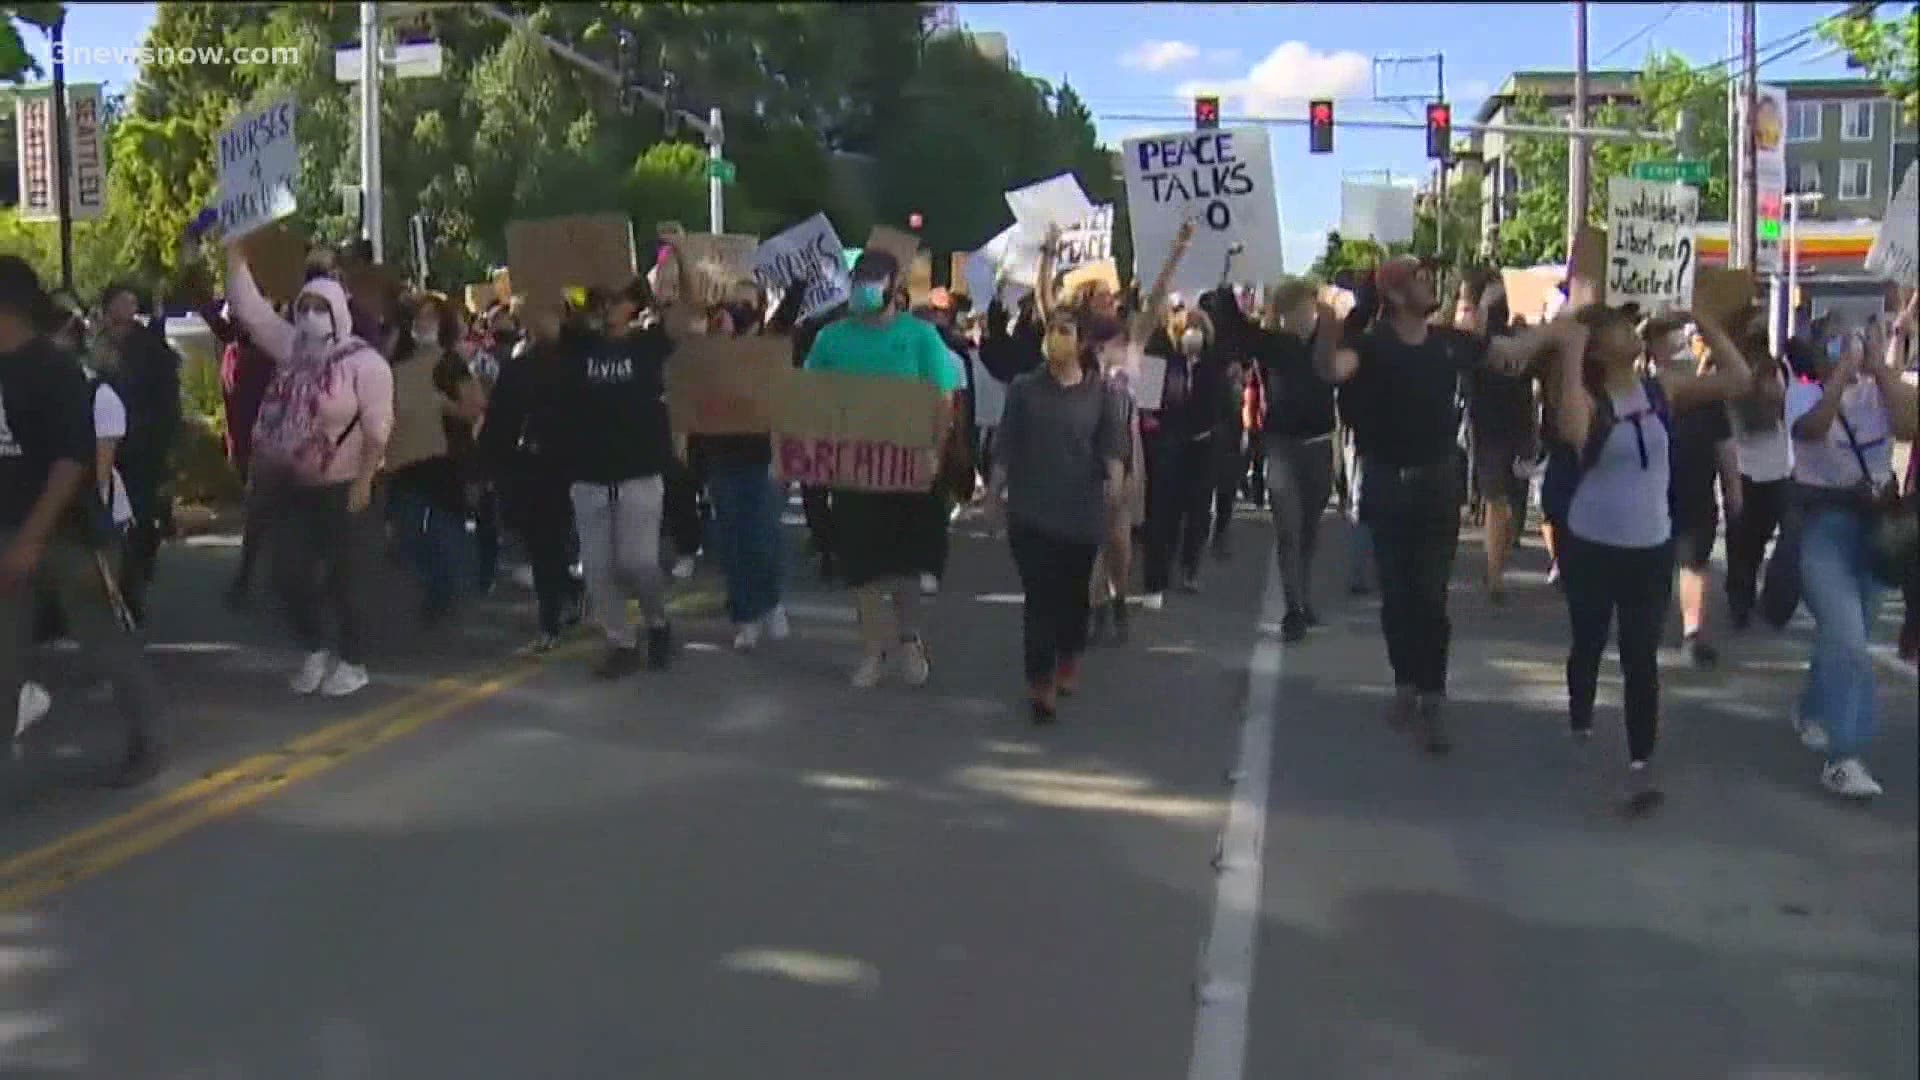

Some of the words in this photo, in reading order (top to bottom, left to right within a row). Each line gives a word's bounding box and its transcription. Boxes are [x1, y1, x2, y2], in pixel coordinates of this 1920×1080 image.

[221, 102, 289, 169] NURSES
[1138, 133, 1237, 171] PEACE
[1142, 162, 1254, 202] TALKS
